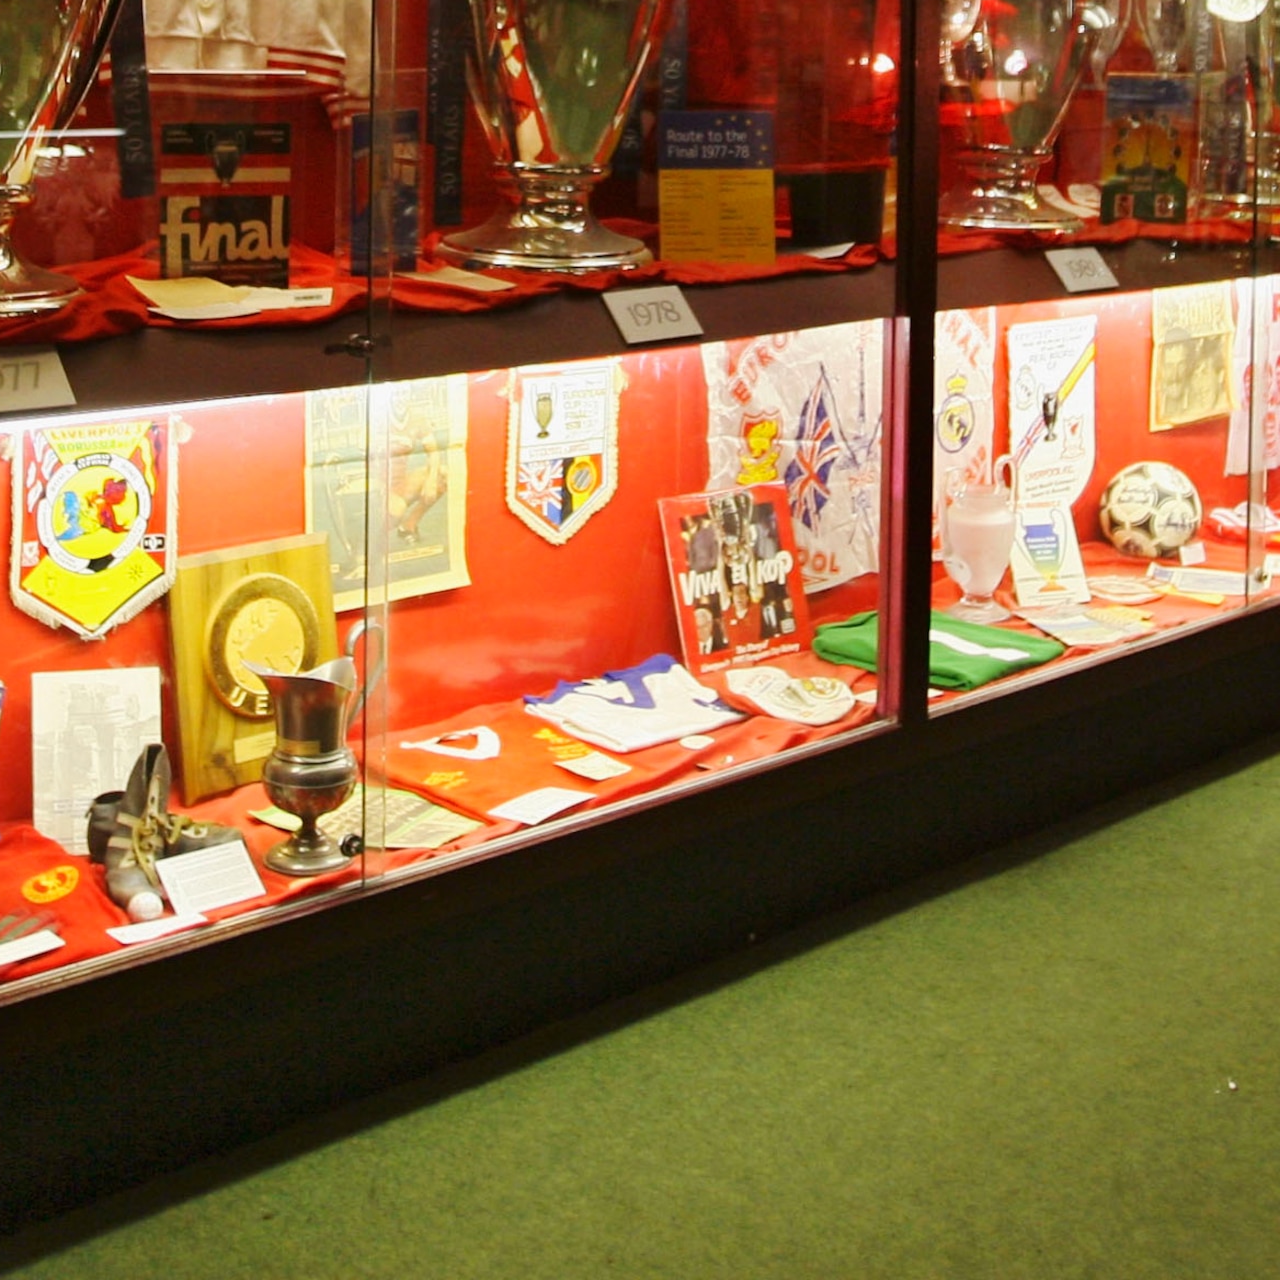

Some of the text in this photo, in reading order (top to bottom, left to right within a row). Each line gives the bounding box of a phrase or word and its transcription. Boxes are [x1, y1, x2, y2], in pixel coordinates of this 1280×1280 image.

[666, 129, 747, 143] Route to the
[667, 144, 750, 159] Final 1977-78
[160, 195, 290, 278] final
[626, 300, 682, 327] 1978
[51, 426, 134, 441] LIVERPOOL
[679, 570, 722, 606] VIVA
[757, 550, 793, 586] KOP
